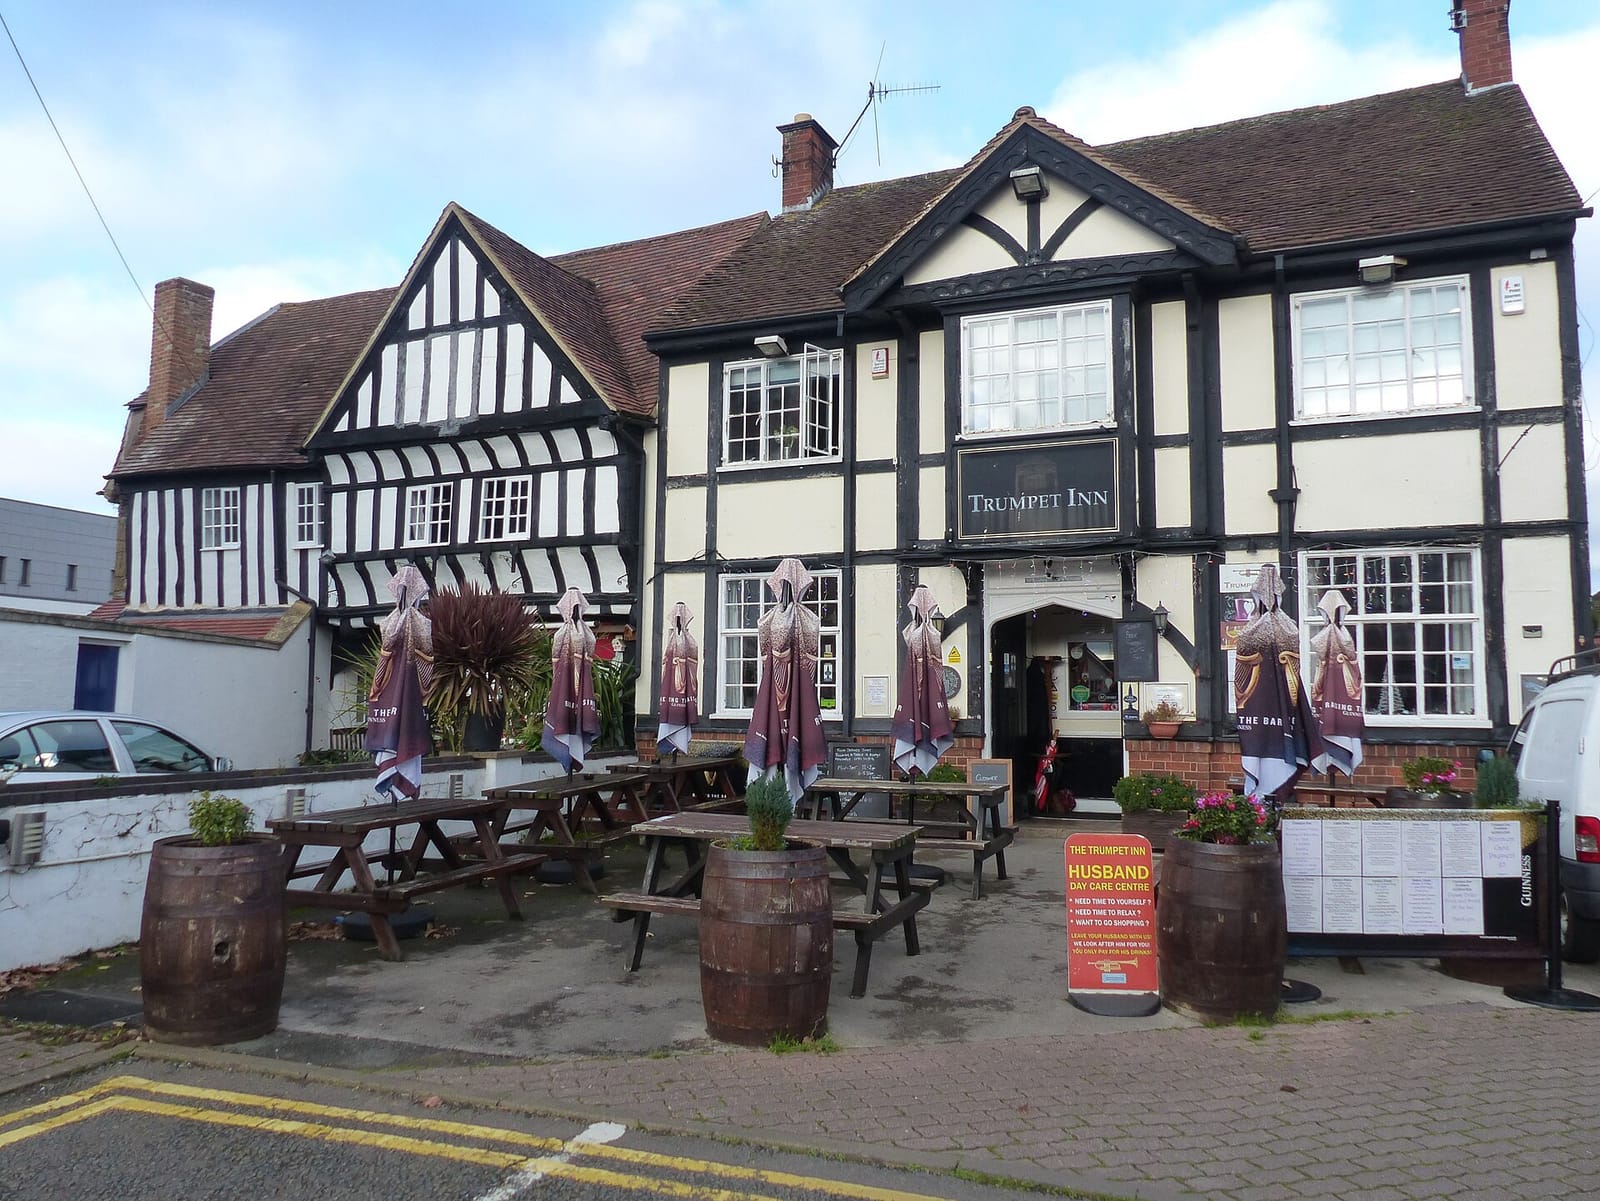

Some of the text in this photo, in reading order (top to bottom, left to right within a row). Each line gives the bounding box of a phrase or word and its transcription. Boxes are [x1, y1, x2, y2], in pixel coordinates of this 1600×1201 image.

[968, 488, 1109, 513] TRUMPET INN
[1223, 581, 1253, 589] TRUMP
[1238, 716, 1283, 727] THE BAR
[1069, 845, 1146, 856] THE TRUMPET INN
[1068, 864, 1150, 880] HUSBAND
[1520, 854, 1532, 907] GUINNESS
[1070, 881, 1150, 892] DAY CARE CENTRE
[1074, 897, 1091, 905] NEED
[1092, 897, 1107, 905] TIME
[1116, 898, 1146, 906] YOURSELF
[1074, 908, 1092, 916] NEED
[1092, 908, 1107, 916] TIME
[1116, 909, 1137, 917] RELAX
[1113, 919, 1145, 927] SHOPPING
